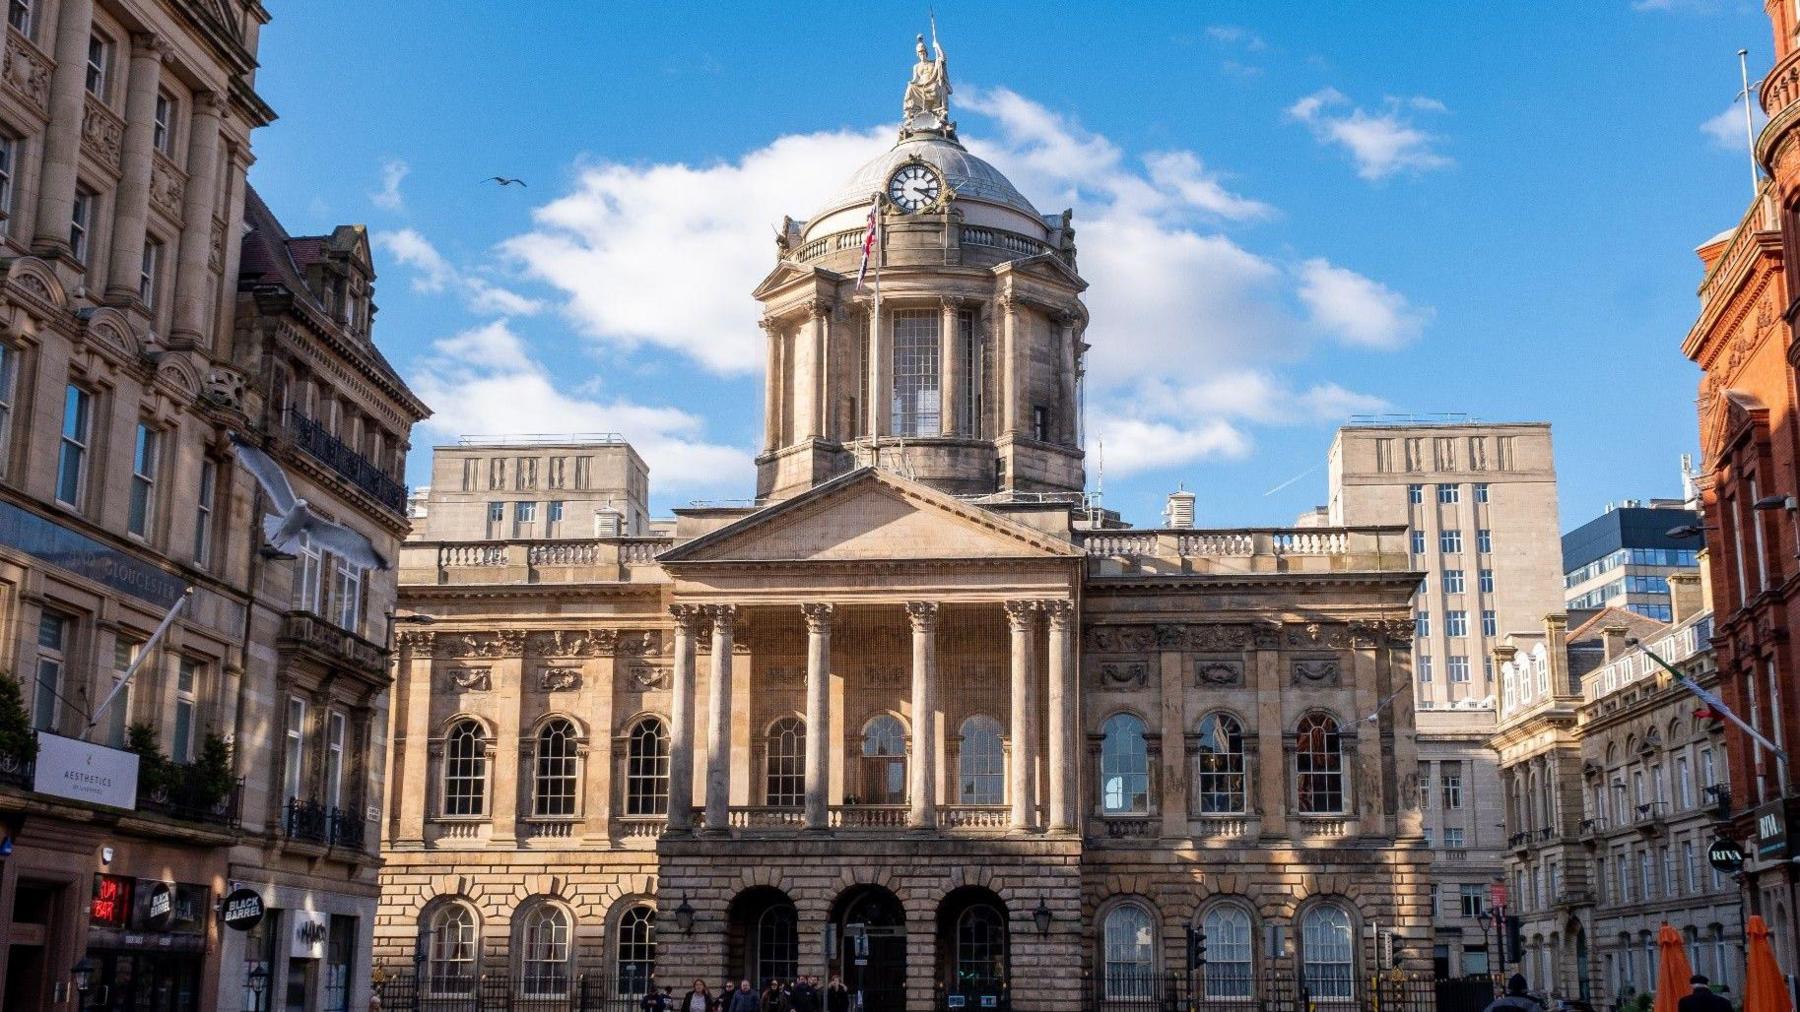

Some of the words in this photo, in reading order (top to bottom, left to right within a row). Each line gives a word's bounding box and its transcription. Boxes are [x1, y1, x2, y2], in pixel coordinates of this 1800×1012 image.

[64, 770, 113, 788] AESTHETICS
[1712, 850, 1742, 861] RIVA
[152, 892, 169, 907] BLACK
[229, 897, 260, 910] BLACK
[94, 901, 114, 921] BAR
[150, 902, 171, 918] BARREL
[225, 906, 262, 921] BARREL
